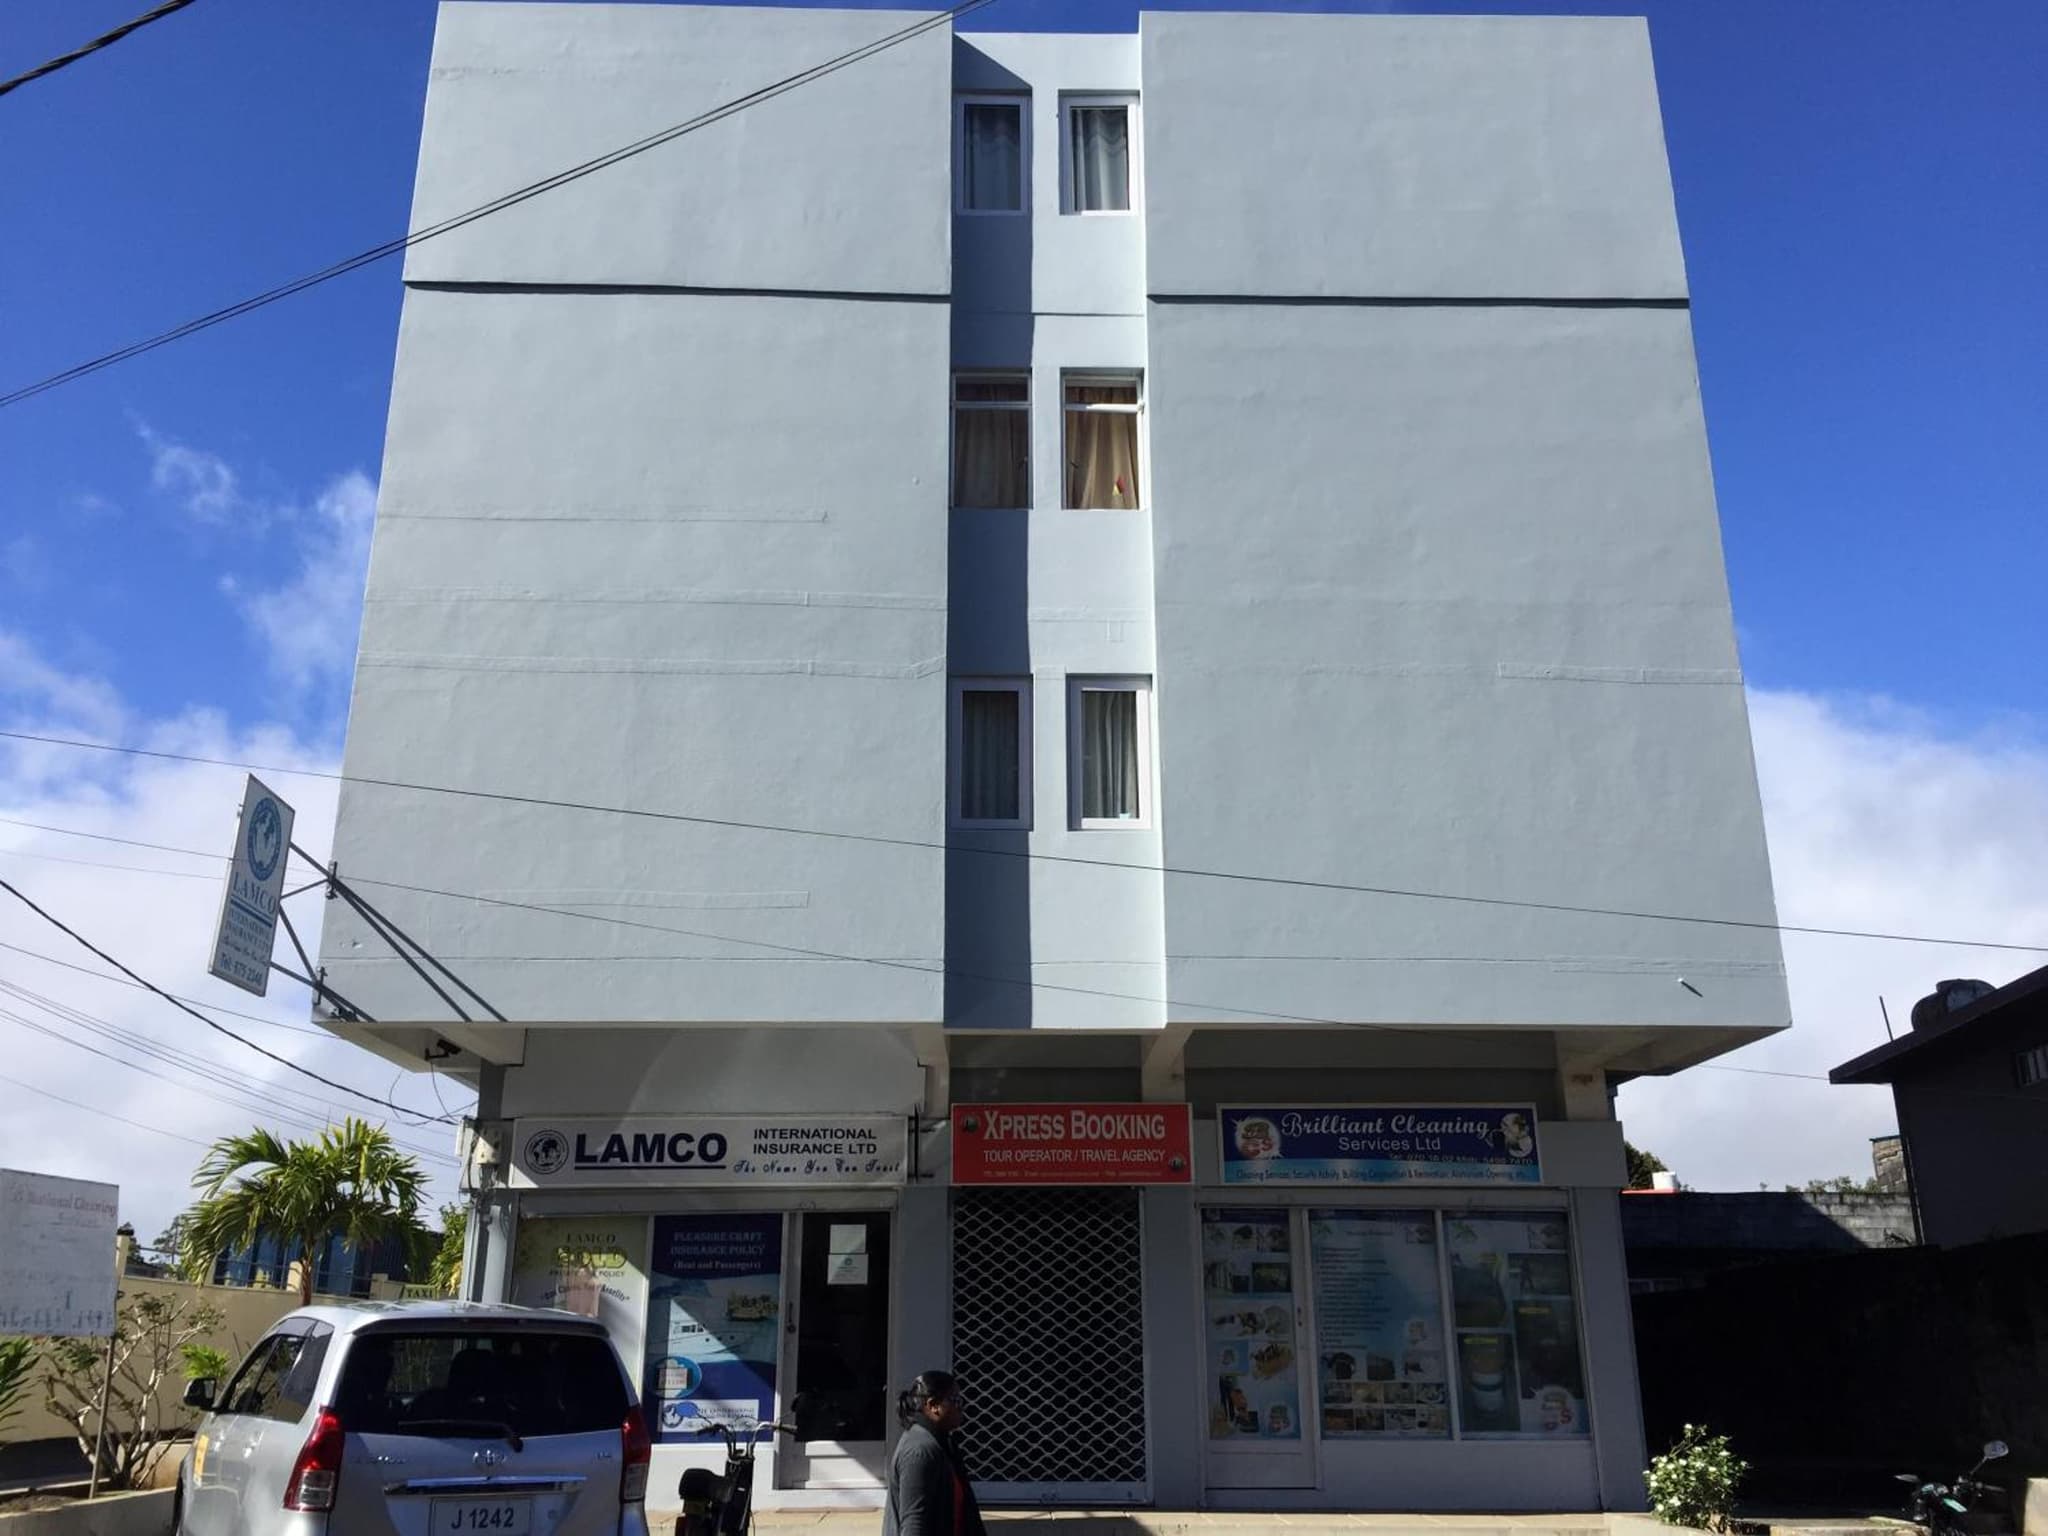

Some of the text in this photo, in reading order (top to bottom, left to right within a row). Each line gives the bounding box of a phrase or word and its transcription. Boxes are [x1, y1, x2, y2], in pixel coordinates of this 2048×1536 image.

[232, 872, 277, 914] LAMCO
[1281, 1112, 1490, 1138] Brilliant Cleaning
[754, 1128, 877, 1139] INTERNATIONAL
[574, 1132, 728, 1163] LAMCO
[753, 1143, 877, 1154] INSURANCE LTD
[1338, 1137, 1441, 1151] Services Ltd
[983, 1149, 1013, 1162] TOUR
[1015, 1149, 1072, 1162] OPERATOR
[1080, 1149, 1120, 1162] TRAVEL
[1122, 1149, 1166, 1162] AGENCY
[567, 1233, 616, 1243] LAMCO
[451, 1508, 515, 1529] J 1242
